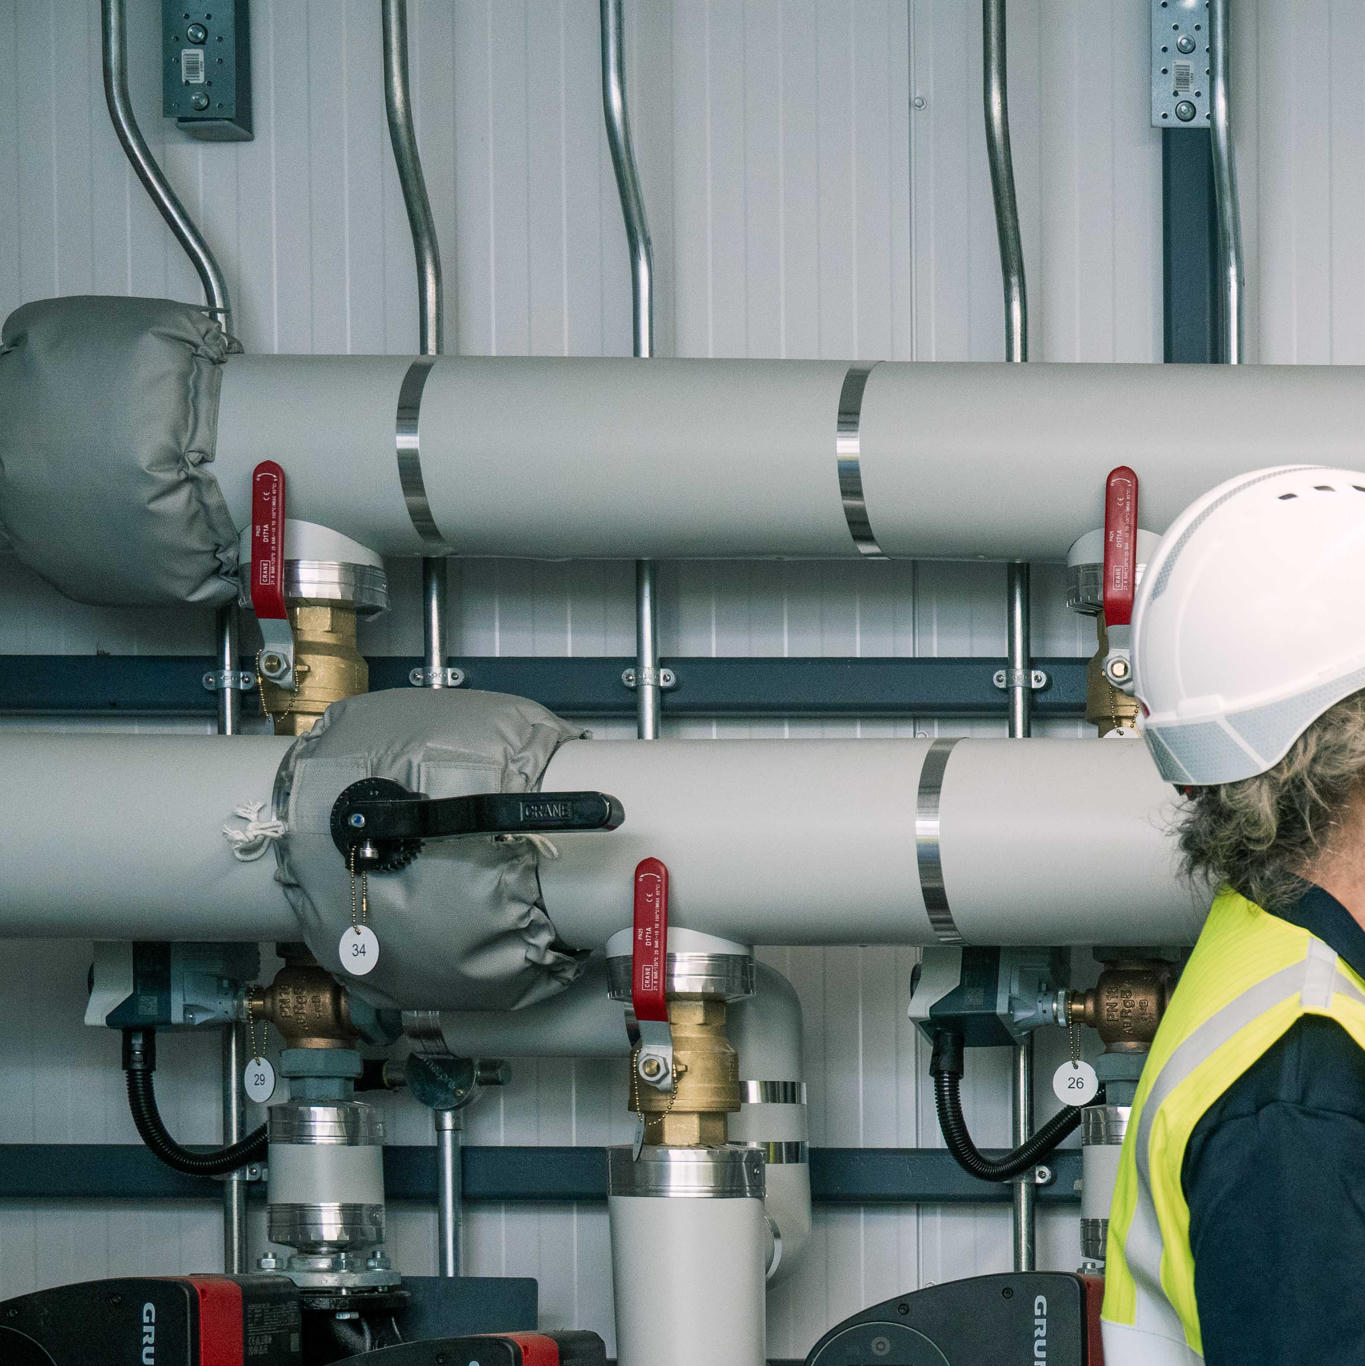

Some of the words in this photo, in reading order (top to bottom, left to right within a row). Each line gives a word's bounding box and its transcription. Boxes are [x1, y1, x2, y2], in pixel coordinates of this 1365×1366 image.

[532, 803, 567, 818] CRANE
[352, 944, 367, 957] 34
[254, 1073, 266, 1085] 29
[1067, 1077, 1085, 1090] 26
